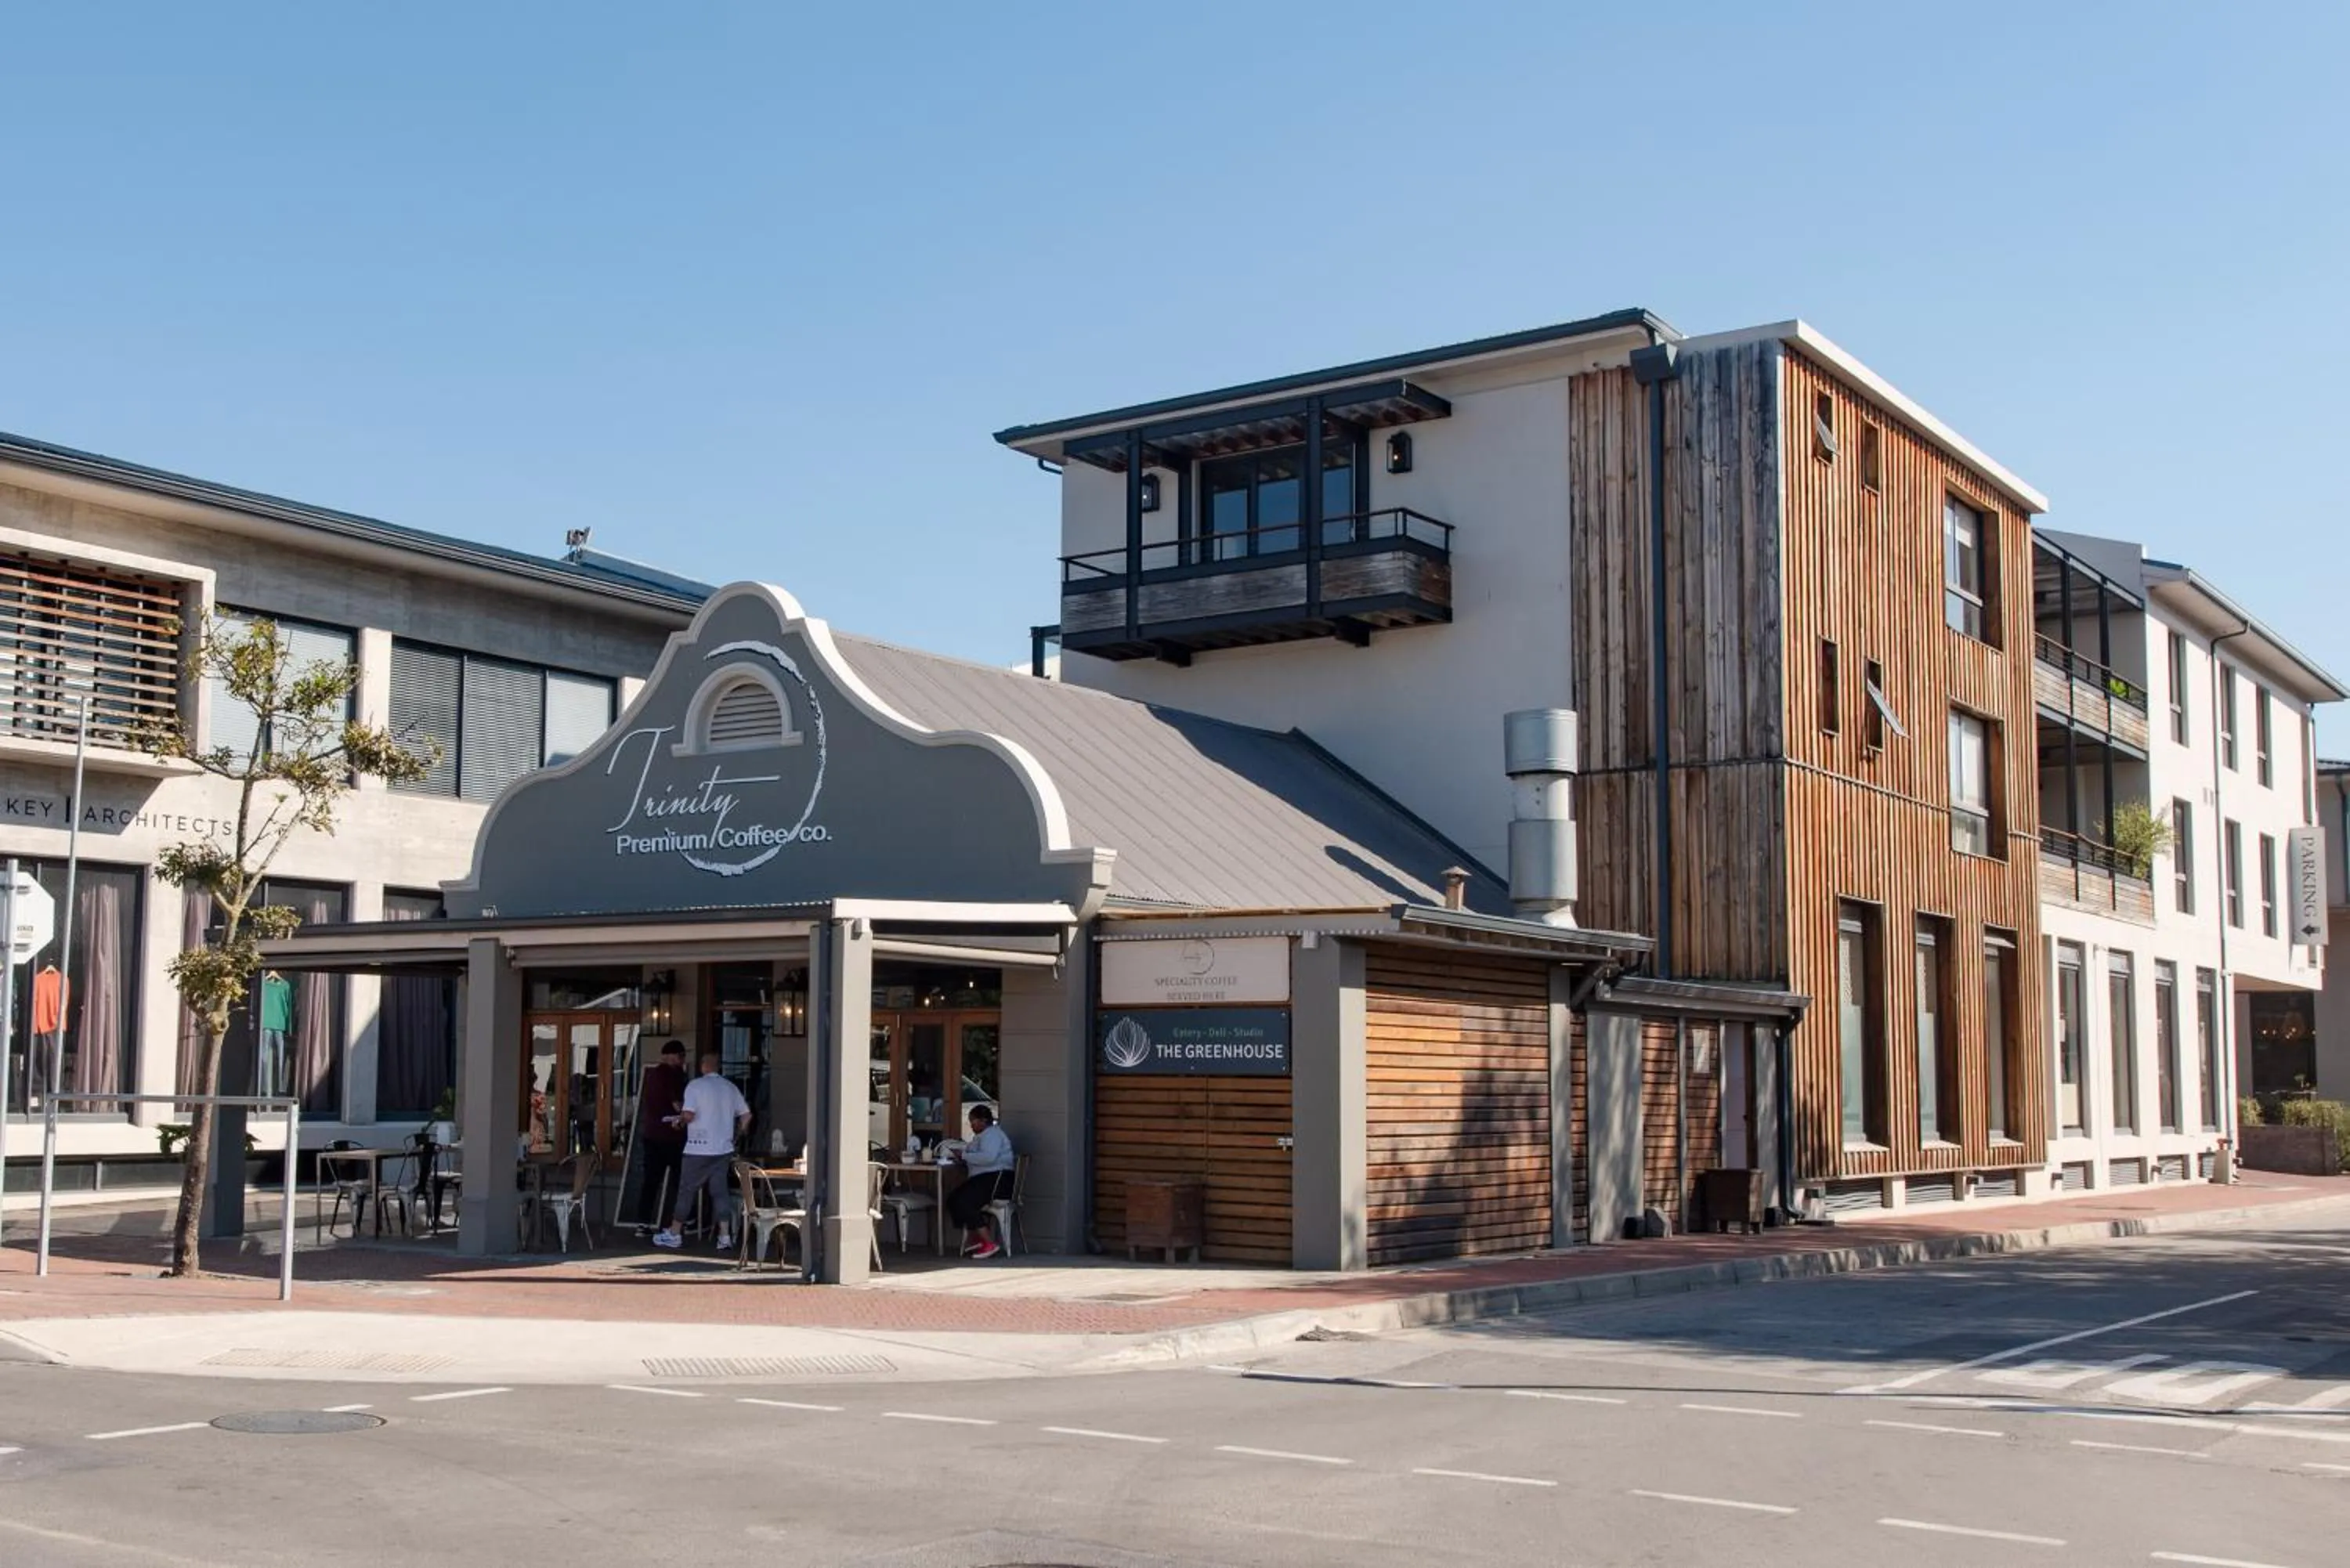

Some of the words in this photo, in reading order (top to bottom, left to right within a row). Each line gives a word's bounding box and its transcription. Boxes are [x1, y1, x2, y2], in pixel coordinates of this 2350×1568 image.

[606, 724, 781, 848] Trinity
[6, 797, 54, 818] KEY
[84, 806, 233, 836] ARCHITECTS
[616, 830, 707, 854] Premium
[718, 824, 790, 848] Coffee
[2301, 836, 2318, 918] PARKING
[1156, 1044, 1182, 1058] THE
[1185, 1043, 1285, 1059] GREENHOUSE
